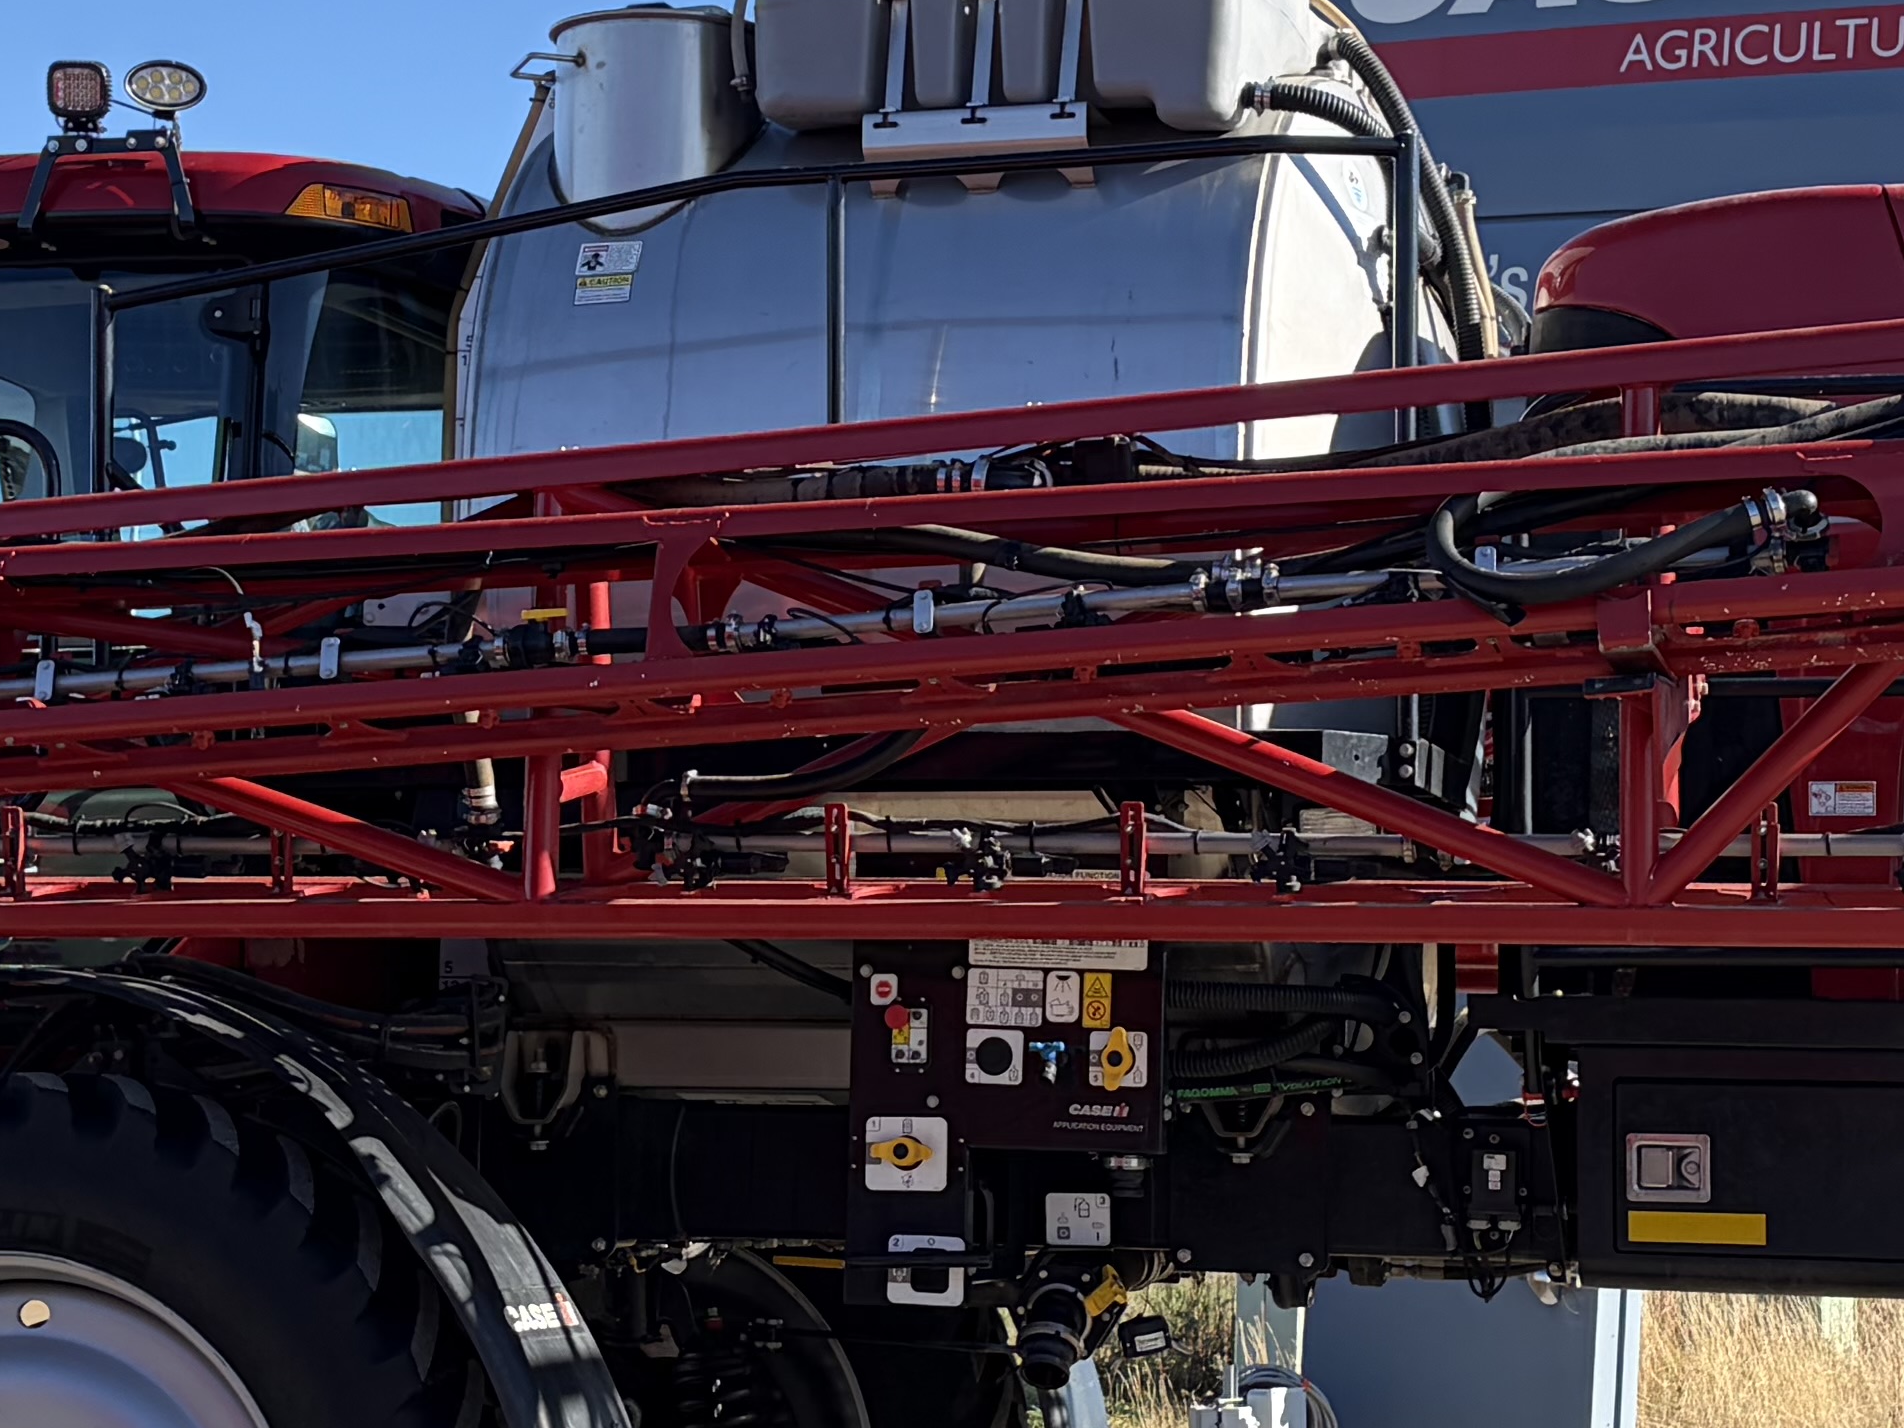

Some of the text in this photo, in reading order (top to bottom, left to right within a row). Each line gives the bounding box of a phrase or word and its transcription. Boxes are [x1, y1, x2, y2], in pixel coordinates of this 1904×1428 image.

[589, 276, 631, 286] CAUTION
[1069, 1103, 1113, 1116] CASE
[1052, 1121, 1144, 1132] APPLICATION EQUIPMENT
[504, 1303, 561, 1332] CASE
